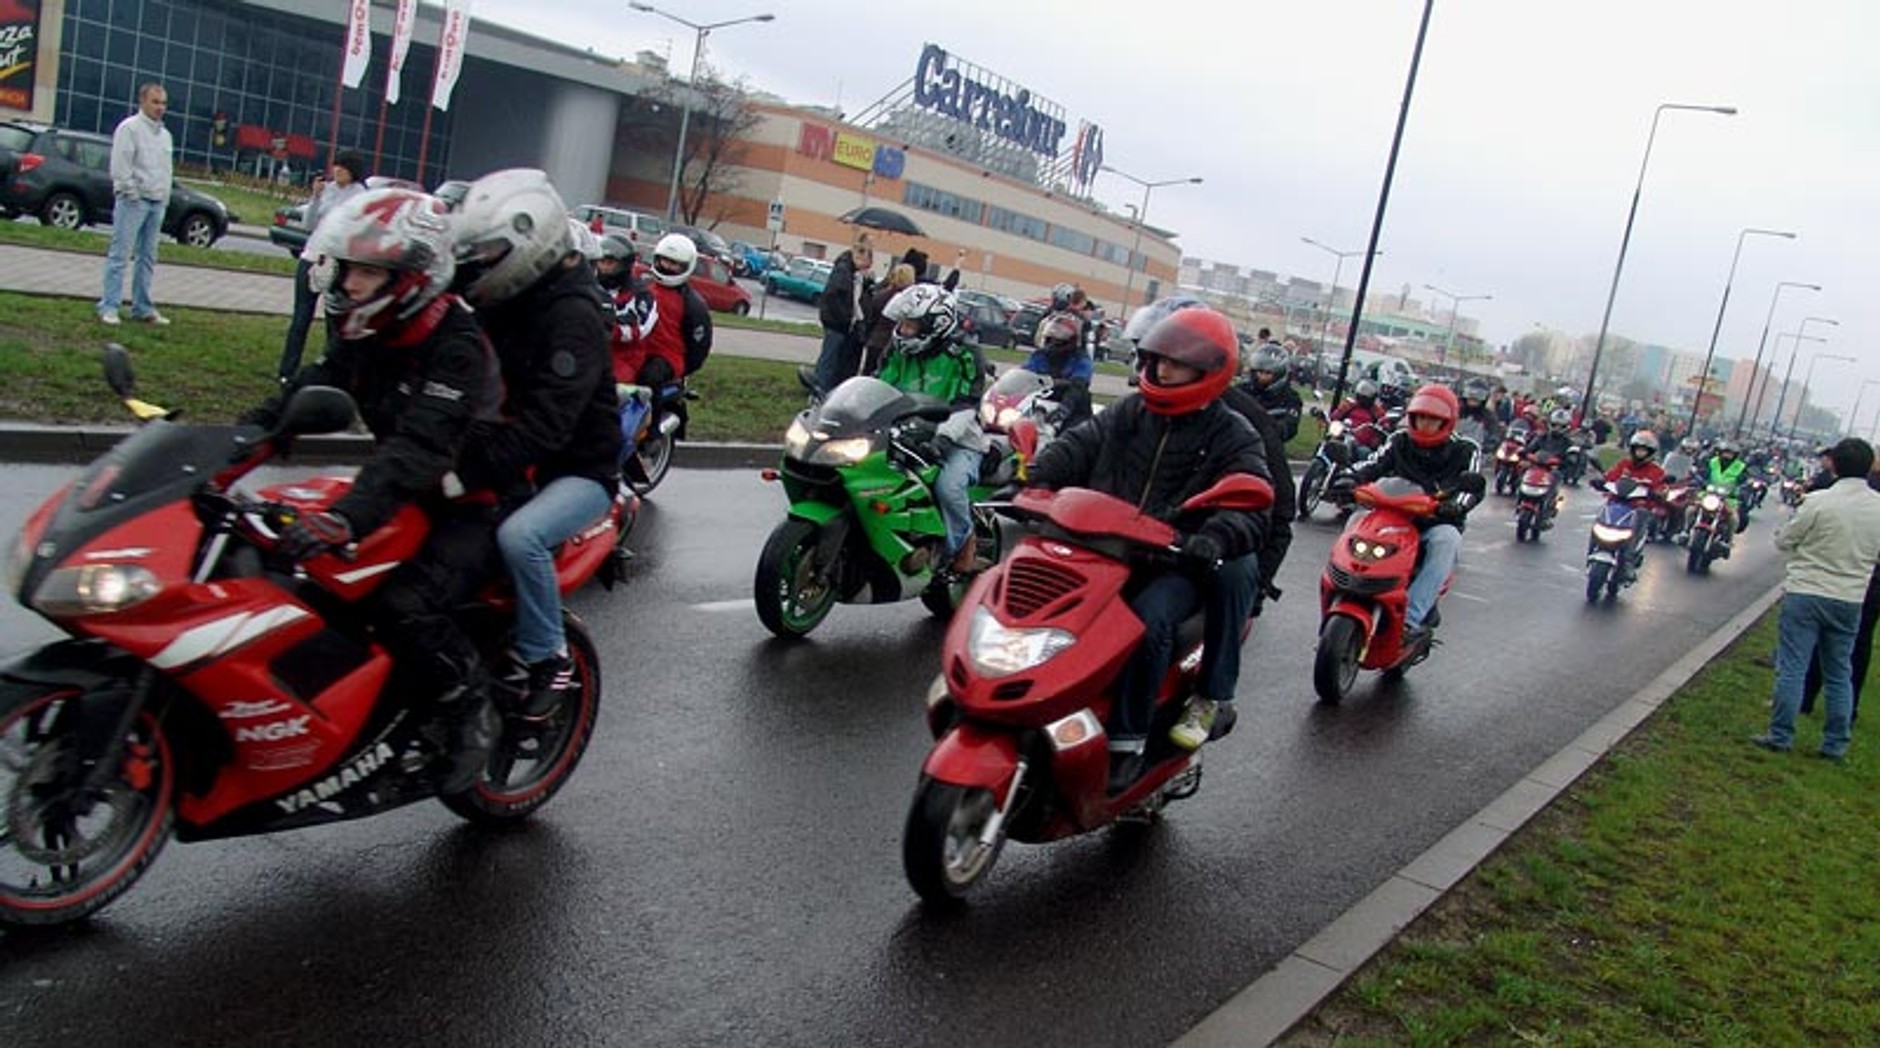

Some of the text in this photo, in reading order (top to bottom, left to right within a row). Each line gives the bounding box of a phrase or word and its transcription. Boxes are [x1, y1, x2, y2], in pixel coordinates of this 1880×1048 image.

[915, 43, 1066, 158] Carrefour
[836, 140, 872, 163] EURO
[235, 714, 311, 742] NGK
[275, 742, 394, 814] YAMAHA
